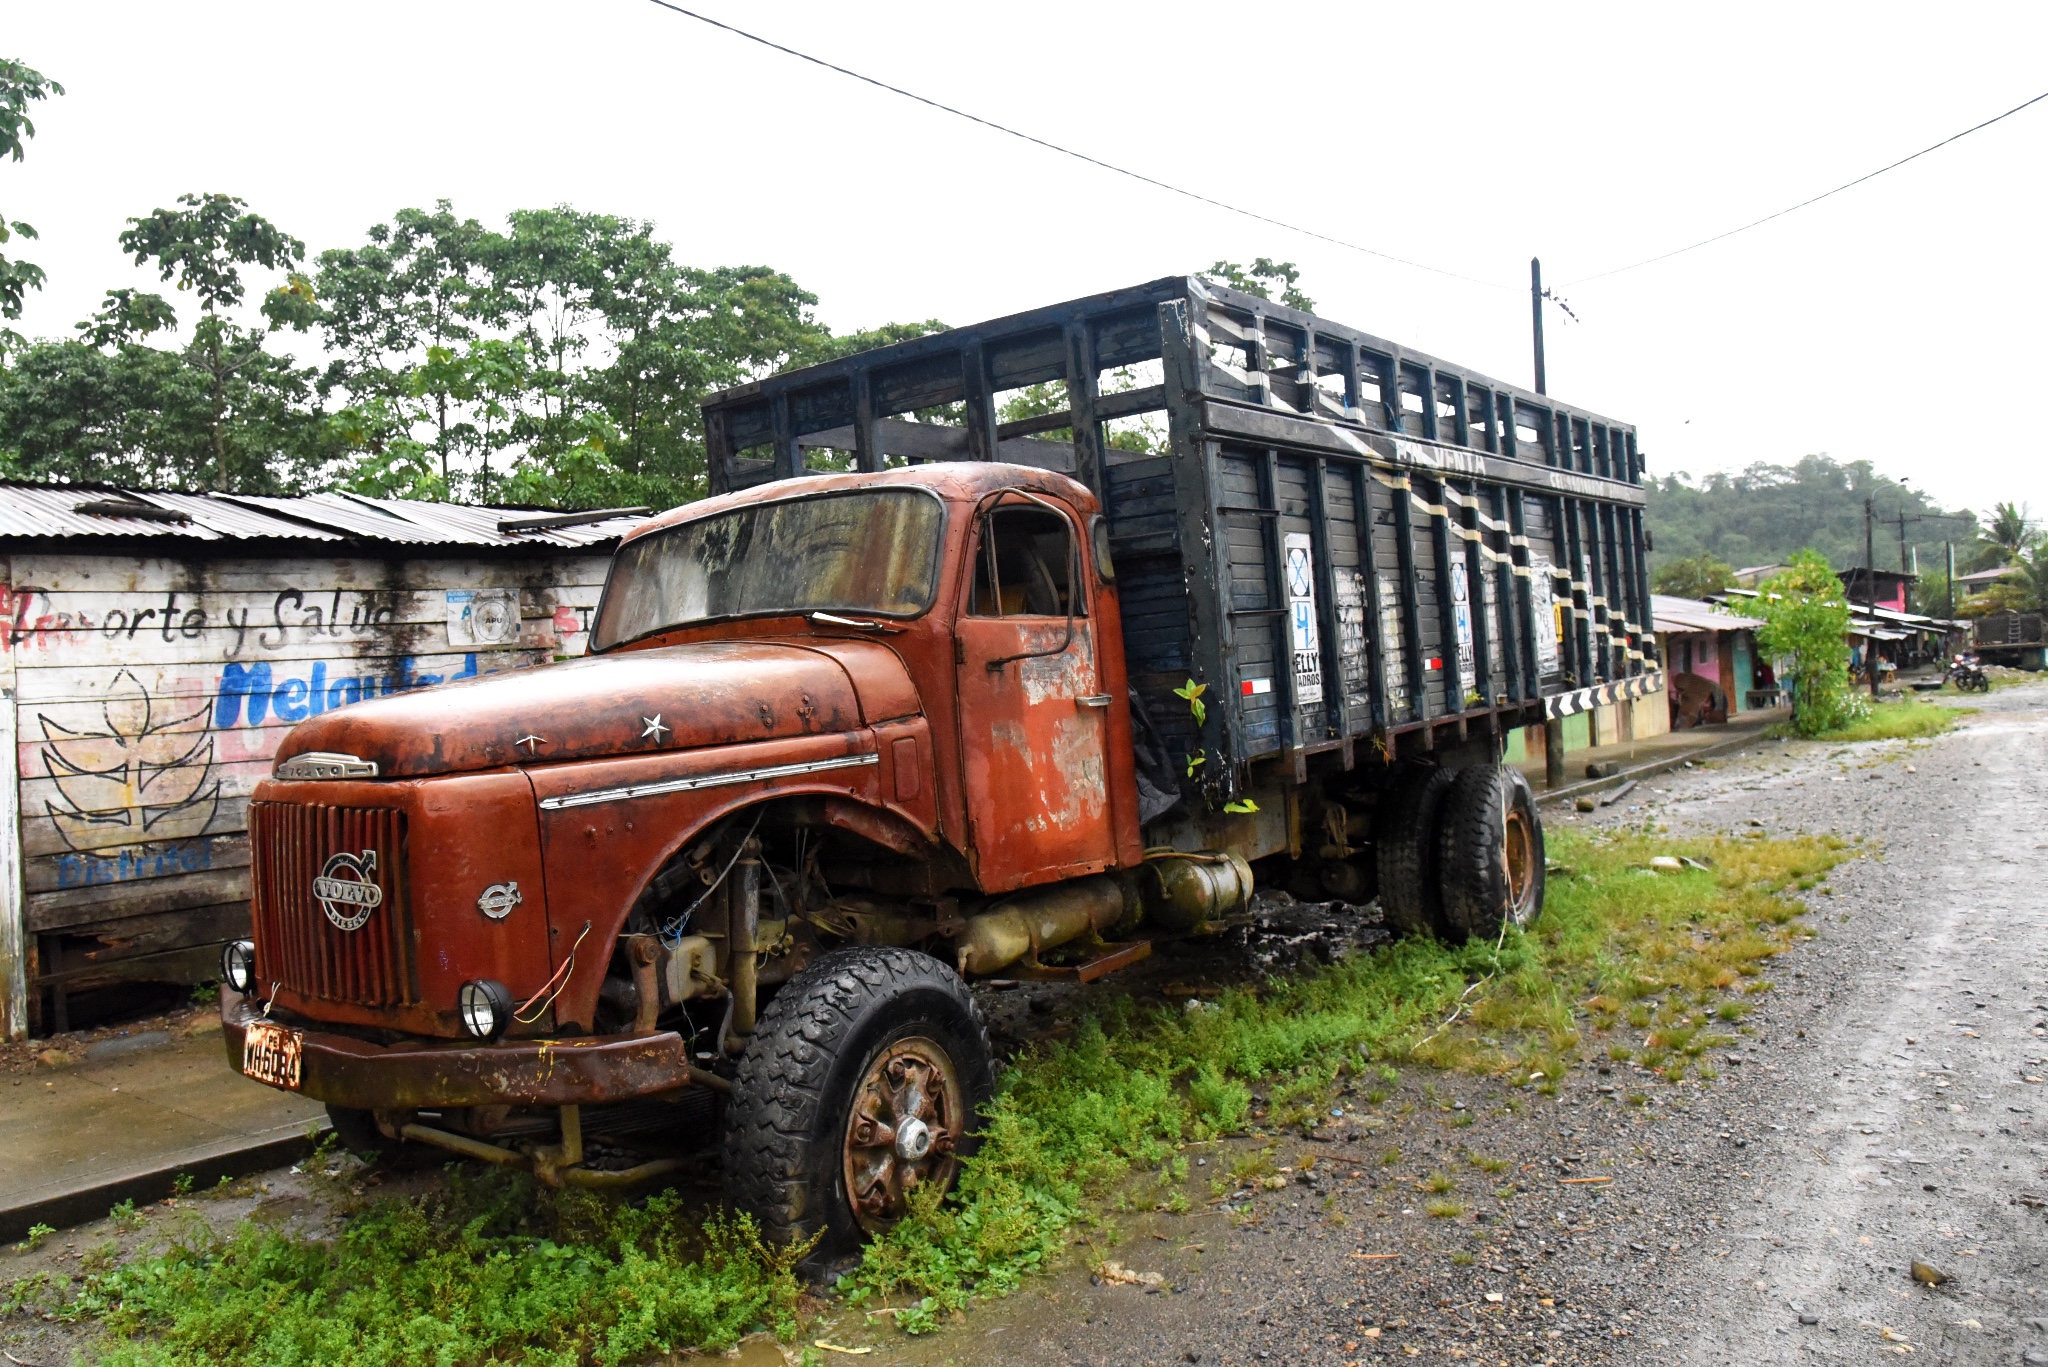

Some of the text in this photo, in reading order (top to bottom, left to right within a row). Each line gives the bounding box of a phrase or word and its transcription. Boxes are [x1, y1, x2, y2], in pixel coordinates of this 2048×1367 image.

[223, 607, 249, 660] y
[317, 879, 379, 904] VOLVO
[330, 911, 366, 929] DIESEL
